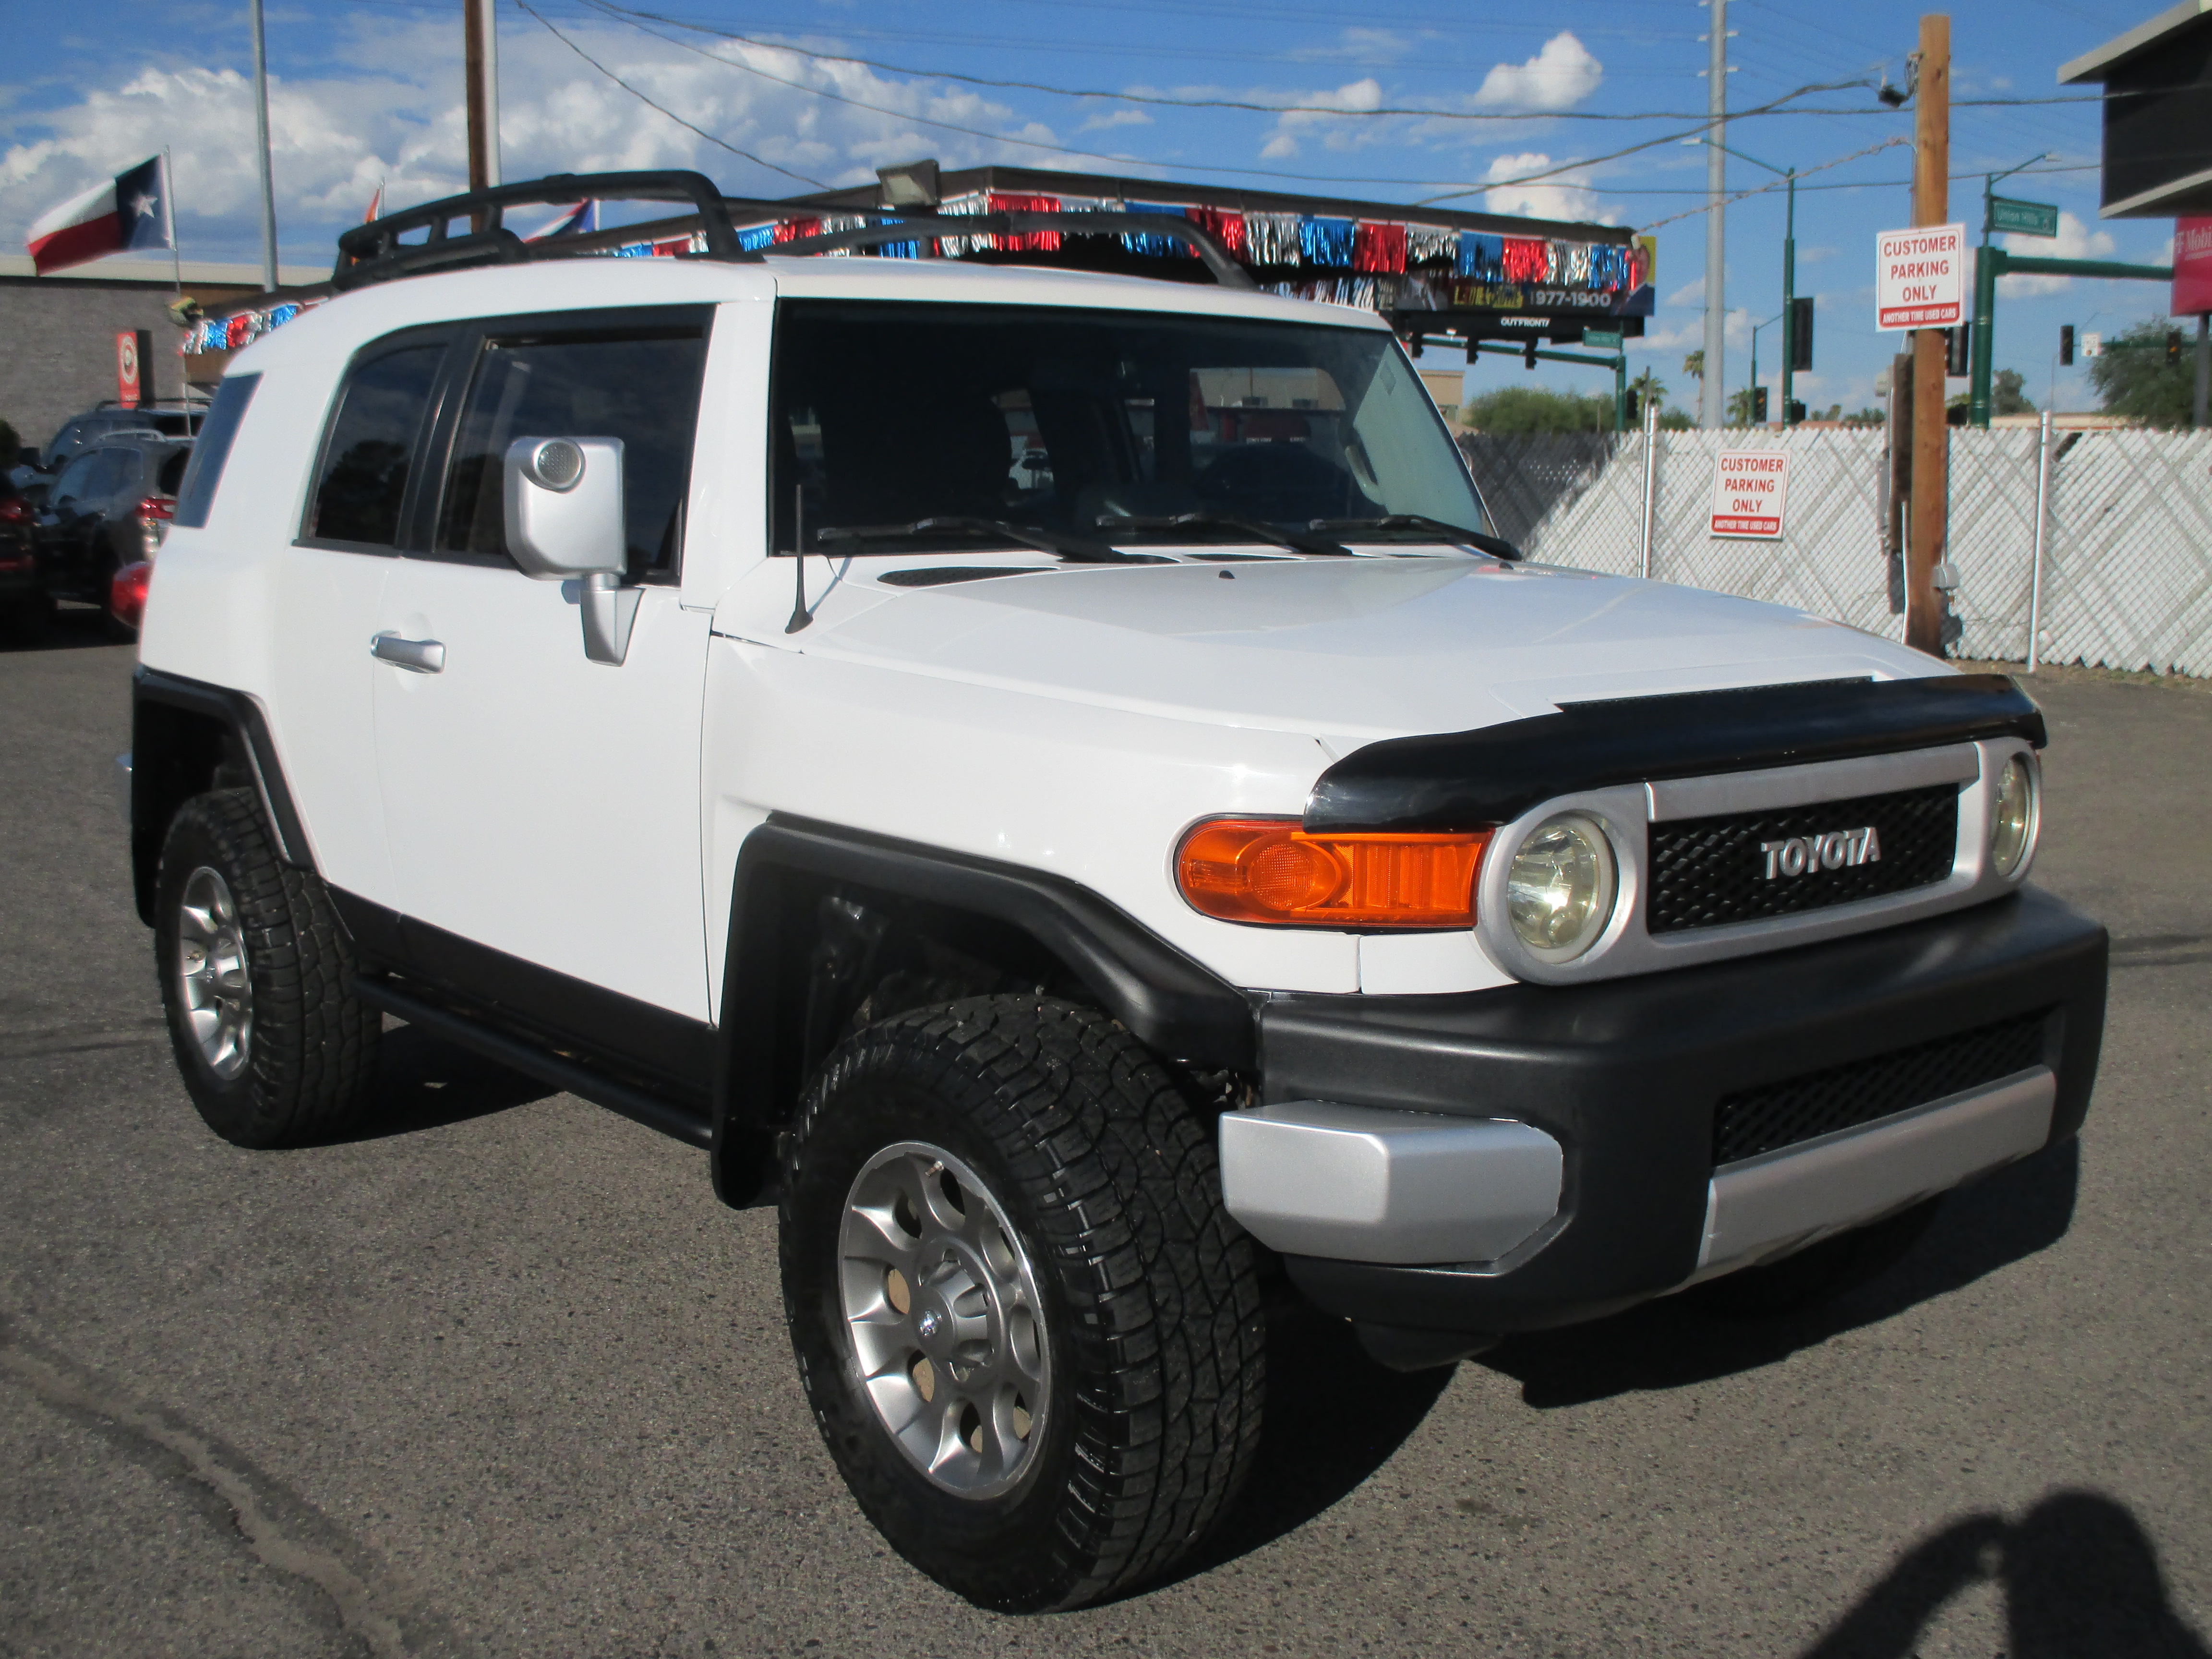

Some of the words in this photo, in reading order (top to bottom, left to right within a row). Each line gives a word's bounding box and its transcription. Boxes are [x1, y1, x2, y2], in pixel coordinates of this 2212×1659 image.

[1884, 236, 1956, 257] CUSTOMER
[1890, 260, 1949, 280] PARKING
[1902, 285, 1937, 302] ONLY
[1883, 312, 1910, 324] ANOTHER
[1911, 311, 1924, 321] TIME
[1925, 310, 1939, 320] USED
[1941, 308, 1956, 319] CARS
[1721, 458, 1783, 472] CUSTOMER
[1724, 478, 1774, 493] PARKING
[1732, 499, 1762, 513] ONLY
[1714, 520, 1737, 529] ANOTHER
[1738, 520, 1749, 529] TIME
[1750, 521, 1763, 530] USED
[1763, 521, 1777, 531] CARS
[1761, 826, 1881, 879] TOYOTA
